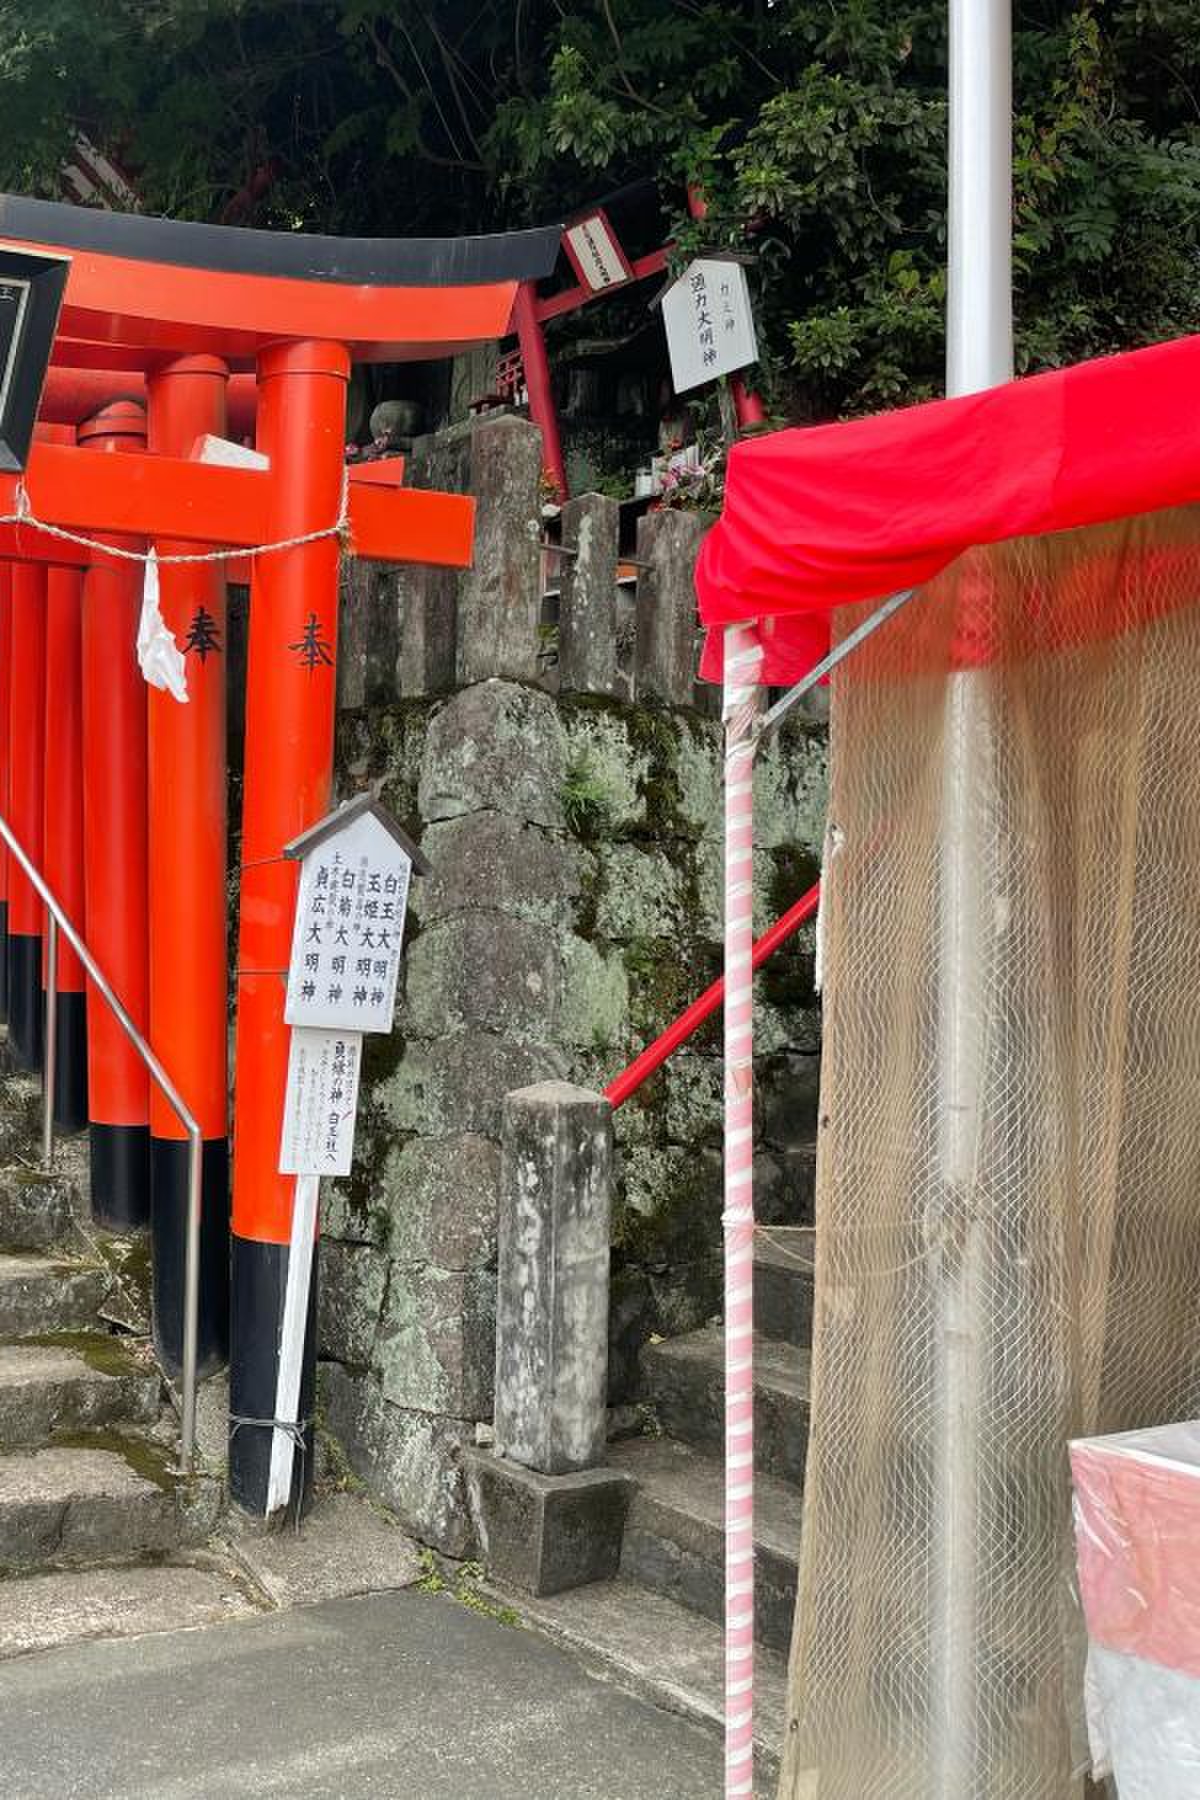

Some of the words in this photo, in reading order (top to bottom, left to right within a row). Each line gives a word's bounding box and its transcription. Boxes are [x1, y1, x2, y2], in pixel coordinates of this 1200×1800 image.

[181, 606, 223, 665] 奉
[288, 611, 334, 672] 奉
[328, 869, 356, 1005] 白菊大明神
[369, 873, 398, 1007] 白玉大明神
